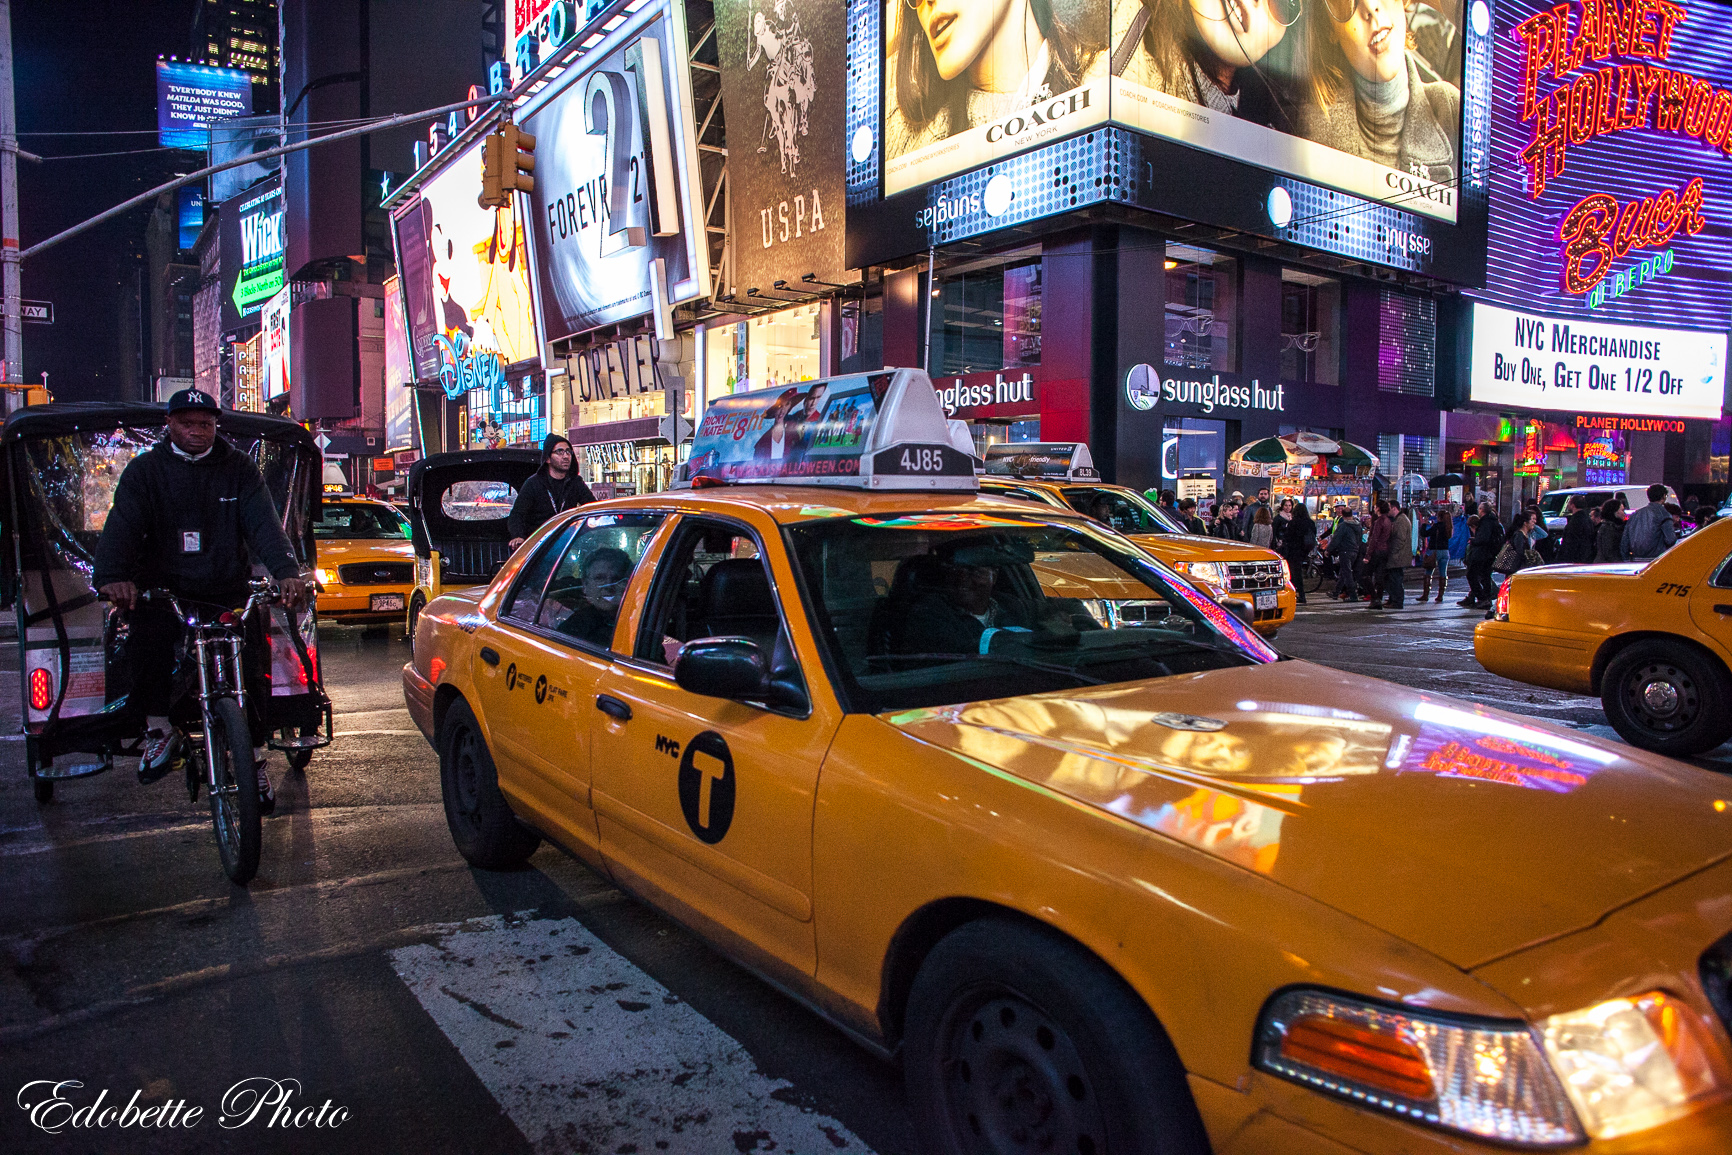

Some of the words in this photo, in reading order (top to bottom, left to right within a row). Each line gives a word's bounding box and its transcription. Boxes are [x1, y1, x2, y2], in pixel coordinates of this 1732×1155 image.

[1517, 0, 1687, 121] PLANET
[167, 94, 200, 104] MATILDA
[202, 97, 219, 105] WAS
[171, 103, 192, 111] THEY
[218, 91, 241, 99] KNEW
[1119, 88, 1148, 104] COACH.COM
[1152, 99, 1210, 124] #COACHNEWYORKSTORIES
[171, 112, 195, 120] KNOW
[986, 88, 1091, 143] COACH
[1014, 134, 1033, 147] NEW
[1035, 125, 1058, 141] YORK
[1470, 147, 1484, 189] hut
[1385, 172, 1451, 206] COACH
[760, 189, 825, 249] USPA
[1561, 177, 1705, 294] BUCA
[1590, 280, 1606, 309] di
[1614, 249, 1674, 297] BEPPO
[1515, 317, 1544, 351] NYC
[566, 331, 666, 405] FOREVER
[1625, 367, 1652, 394] 1/2
[995, 372, 1034, 402] hut
[1162, 374, 1250, 413] sunglass
[1251, 378, 1285, 411] hut
[703, 414, 727, 426] RICKY
[703, 425, 724, 437] KATE
[1577, 415, 1619, 430] PLANET
[1620, 418, 1685, 433] HOLLYWOOD
[585, 443, 626, 466] FOREVER
[901, 449, 943, 472] 4J85
[1656, 582, 1691, 598] 2T15
[655, 734, 680, 758] NYC
[692, 750, 725, 829] T
